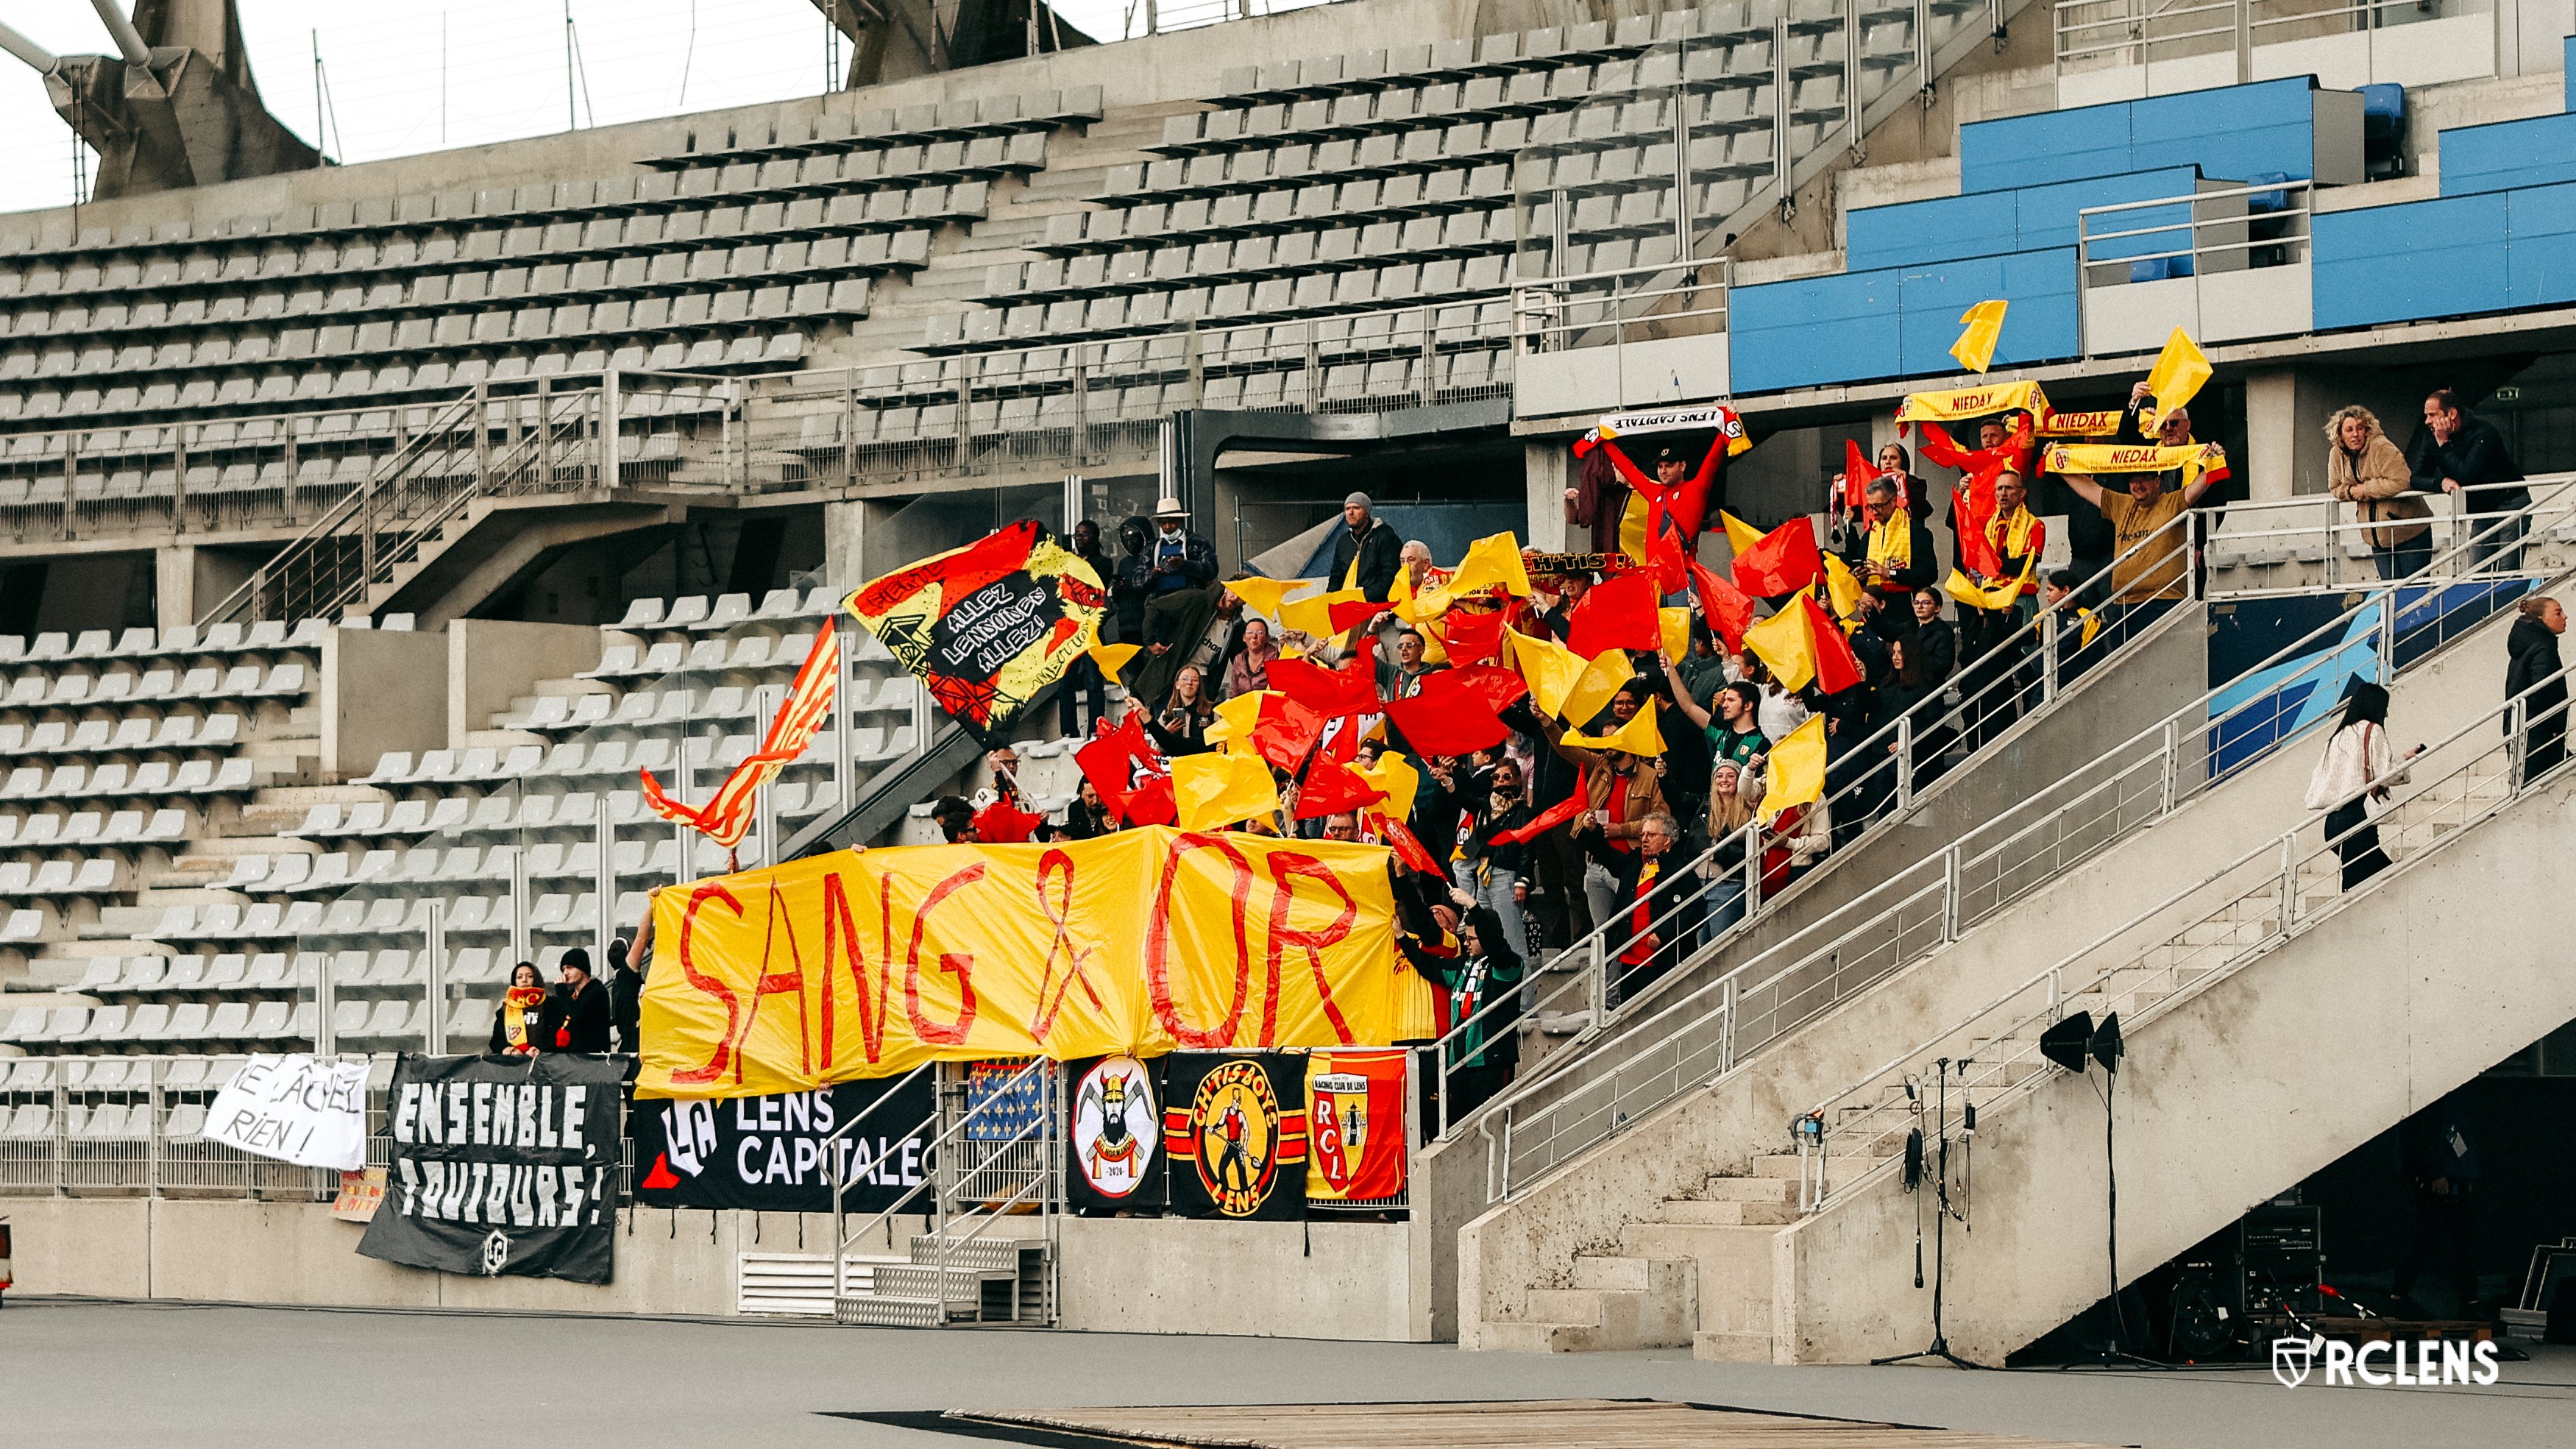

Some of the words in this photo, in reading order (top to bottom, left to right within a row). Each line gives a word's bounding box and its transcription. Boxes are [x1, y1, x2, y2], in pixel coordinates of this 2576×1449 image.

[2057, 412, 2108, 428] NIEDAX
[2111, 448, 2160, 464] NIEDAX
[947, 584, 1014, 633] ALLEZ
[672, 861, 985, 1085] SANG
[1032, 849, 1101, 1044] &
[1146, 832, 1356, 1048] OR
[1315, 1080, 1333, 1090] RACING
[1334, 1082, 1345, 1090] CLUB
[1346, 1082, 1353, 1091] DE
[1354, 1081, 1365, 1090] LENS
[737, 1089, 834, 1133] LENS
[737, 1136, 922, 1187] CAPITALE
[1211, 1183, 1260, 1213] LENS
